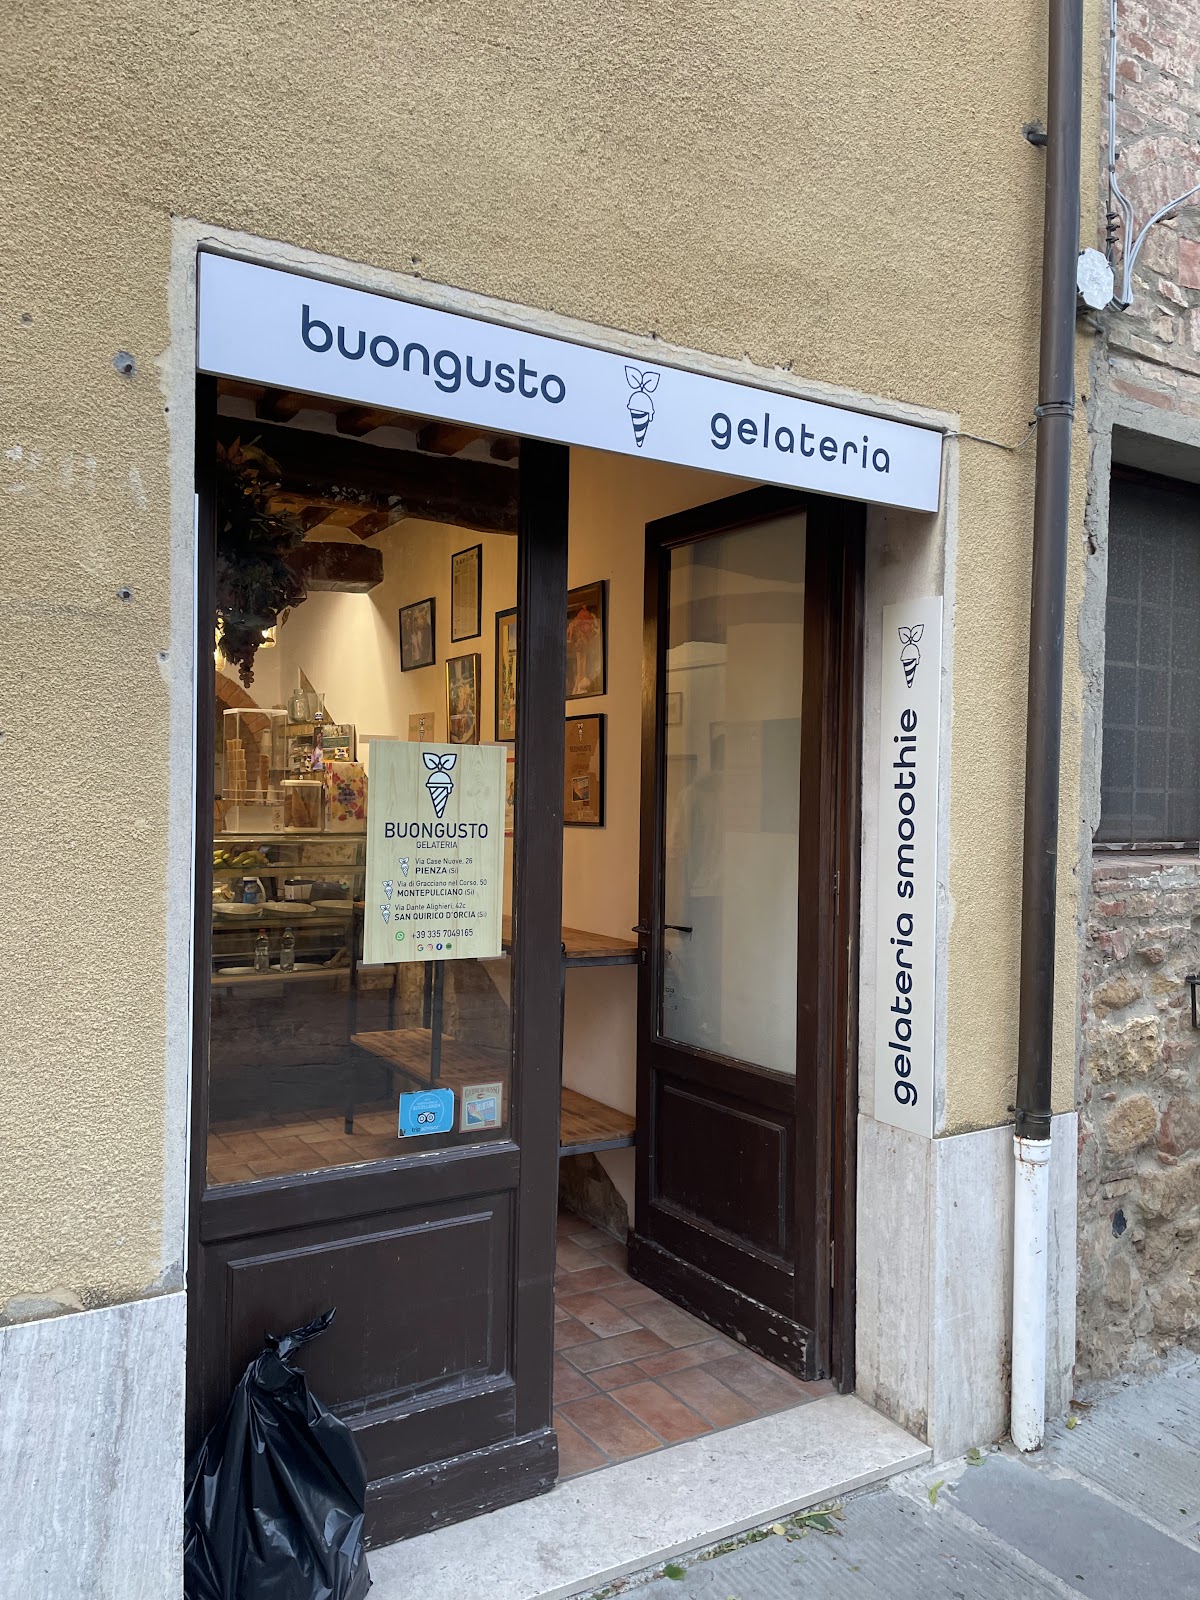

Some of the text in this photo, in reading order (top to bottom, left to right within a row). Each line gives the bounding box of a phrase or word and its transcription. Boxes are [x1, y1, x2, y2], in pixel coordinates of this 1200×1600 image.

[300, 303, 890, 473] buongusto gelateria
[384, 822, 488, 839] BUONGUSTO
[416, 841, 458, 849] GELATERIA
[415, 857, 425, 865] Via
[426, 857, 442, 865] Case
[415, 867, 447, 875] PIENZA
[397, 888, 463, 897] MONTEPULCIANO
[888, 708, 918, 1106] gelateria smoothie
[394, 913, 411, 921] SAN
[413, 912, 444, 920] QUIRICO
[445, 911, 476, 919] D'ORCIA
[411, 928, 474, 939] +39 335 7049165
